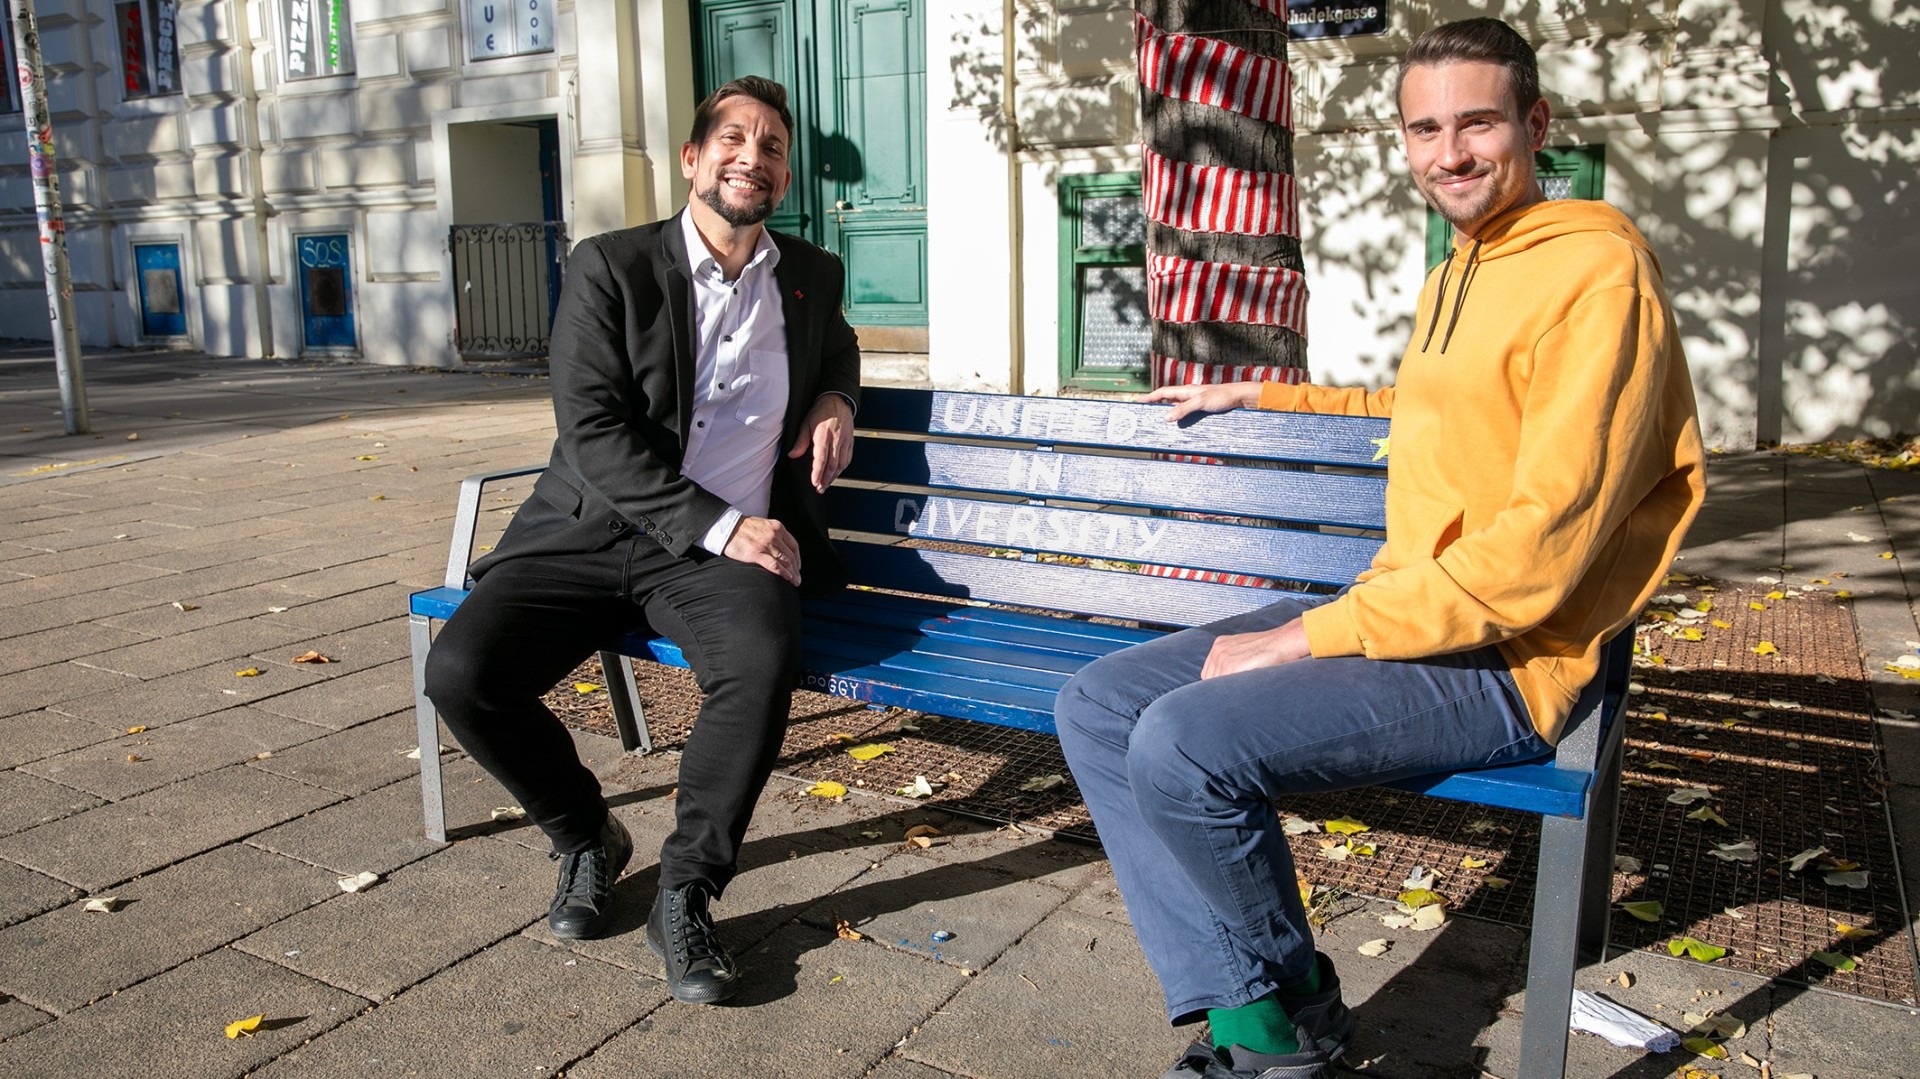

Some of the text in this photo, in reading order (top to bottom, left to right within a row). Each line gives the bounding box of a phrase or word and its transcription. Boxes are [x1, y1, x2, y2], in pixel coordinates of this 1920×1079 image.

[126, 8, 143, 92] PIZZA
[289, 0, 310, 73] PIZZ
[944, 397, 1138, 443] UNITED
[1008, 450, 1064, 492] IN
[894, 497, 1167, 557] DIVERSITY
[807, 675, 860, 699] DOGGY
